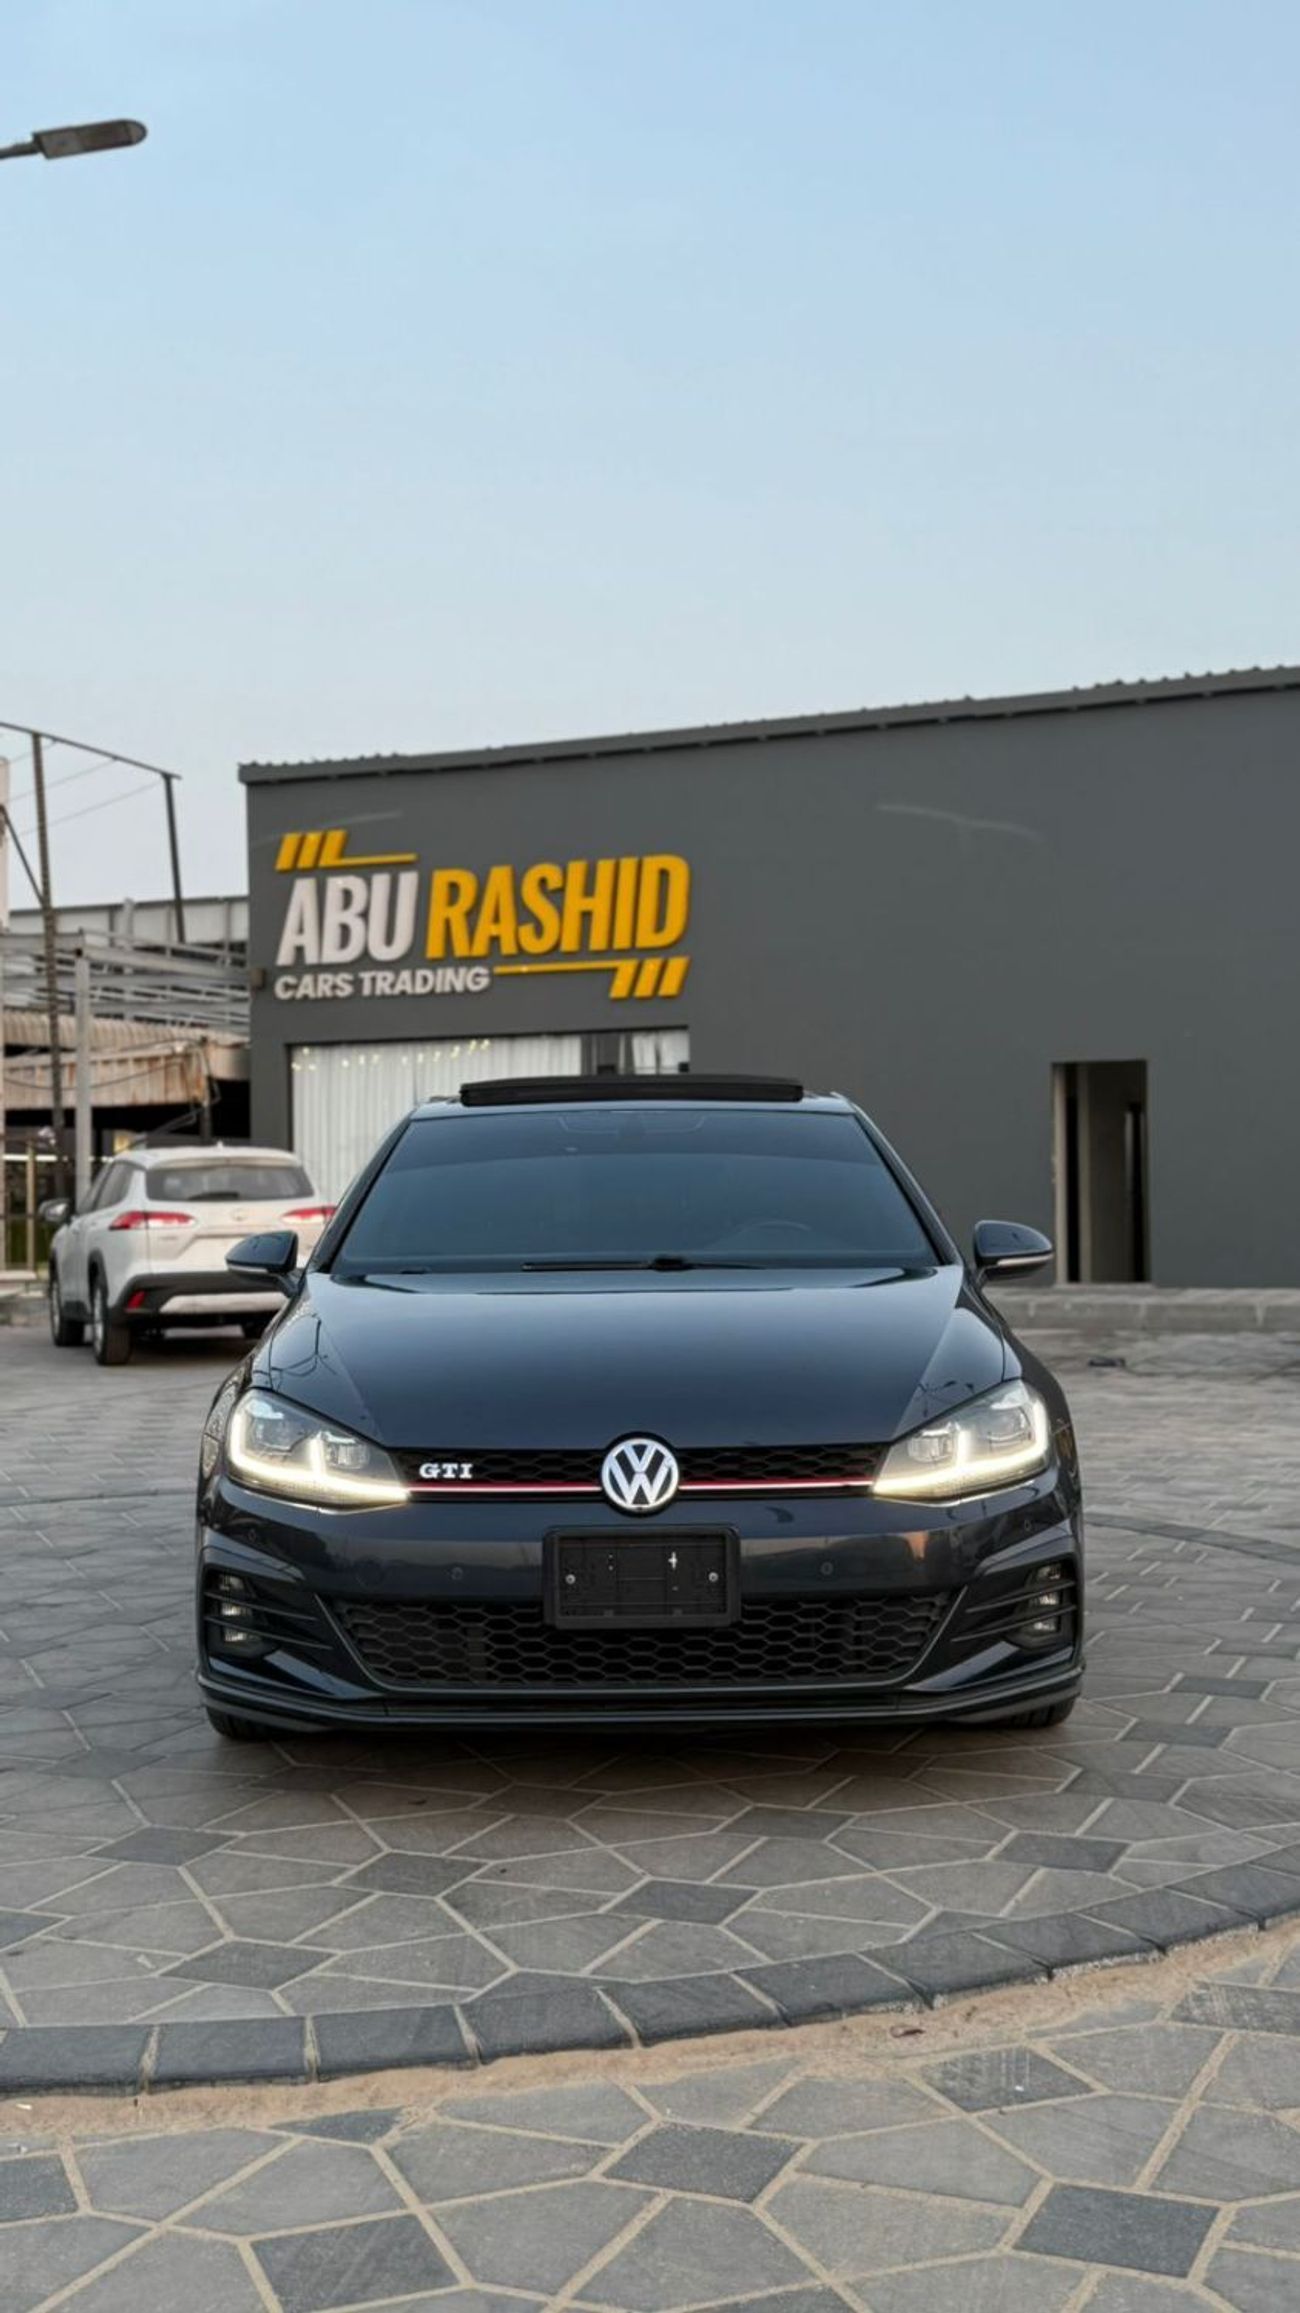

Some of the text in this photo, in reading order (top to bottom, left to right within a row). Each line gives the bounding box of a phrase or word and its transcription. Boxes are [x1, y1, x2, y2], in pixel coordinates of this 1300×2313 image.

[275, 854, 690, 966] ABU RASHID
[274, 966, 490, 1000] CARS TRADING
[419, 1462, 473, 1479] GTI
